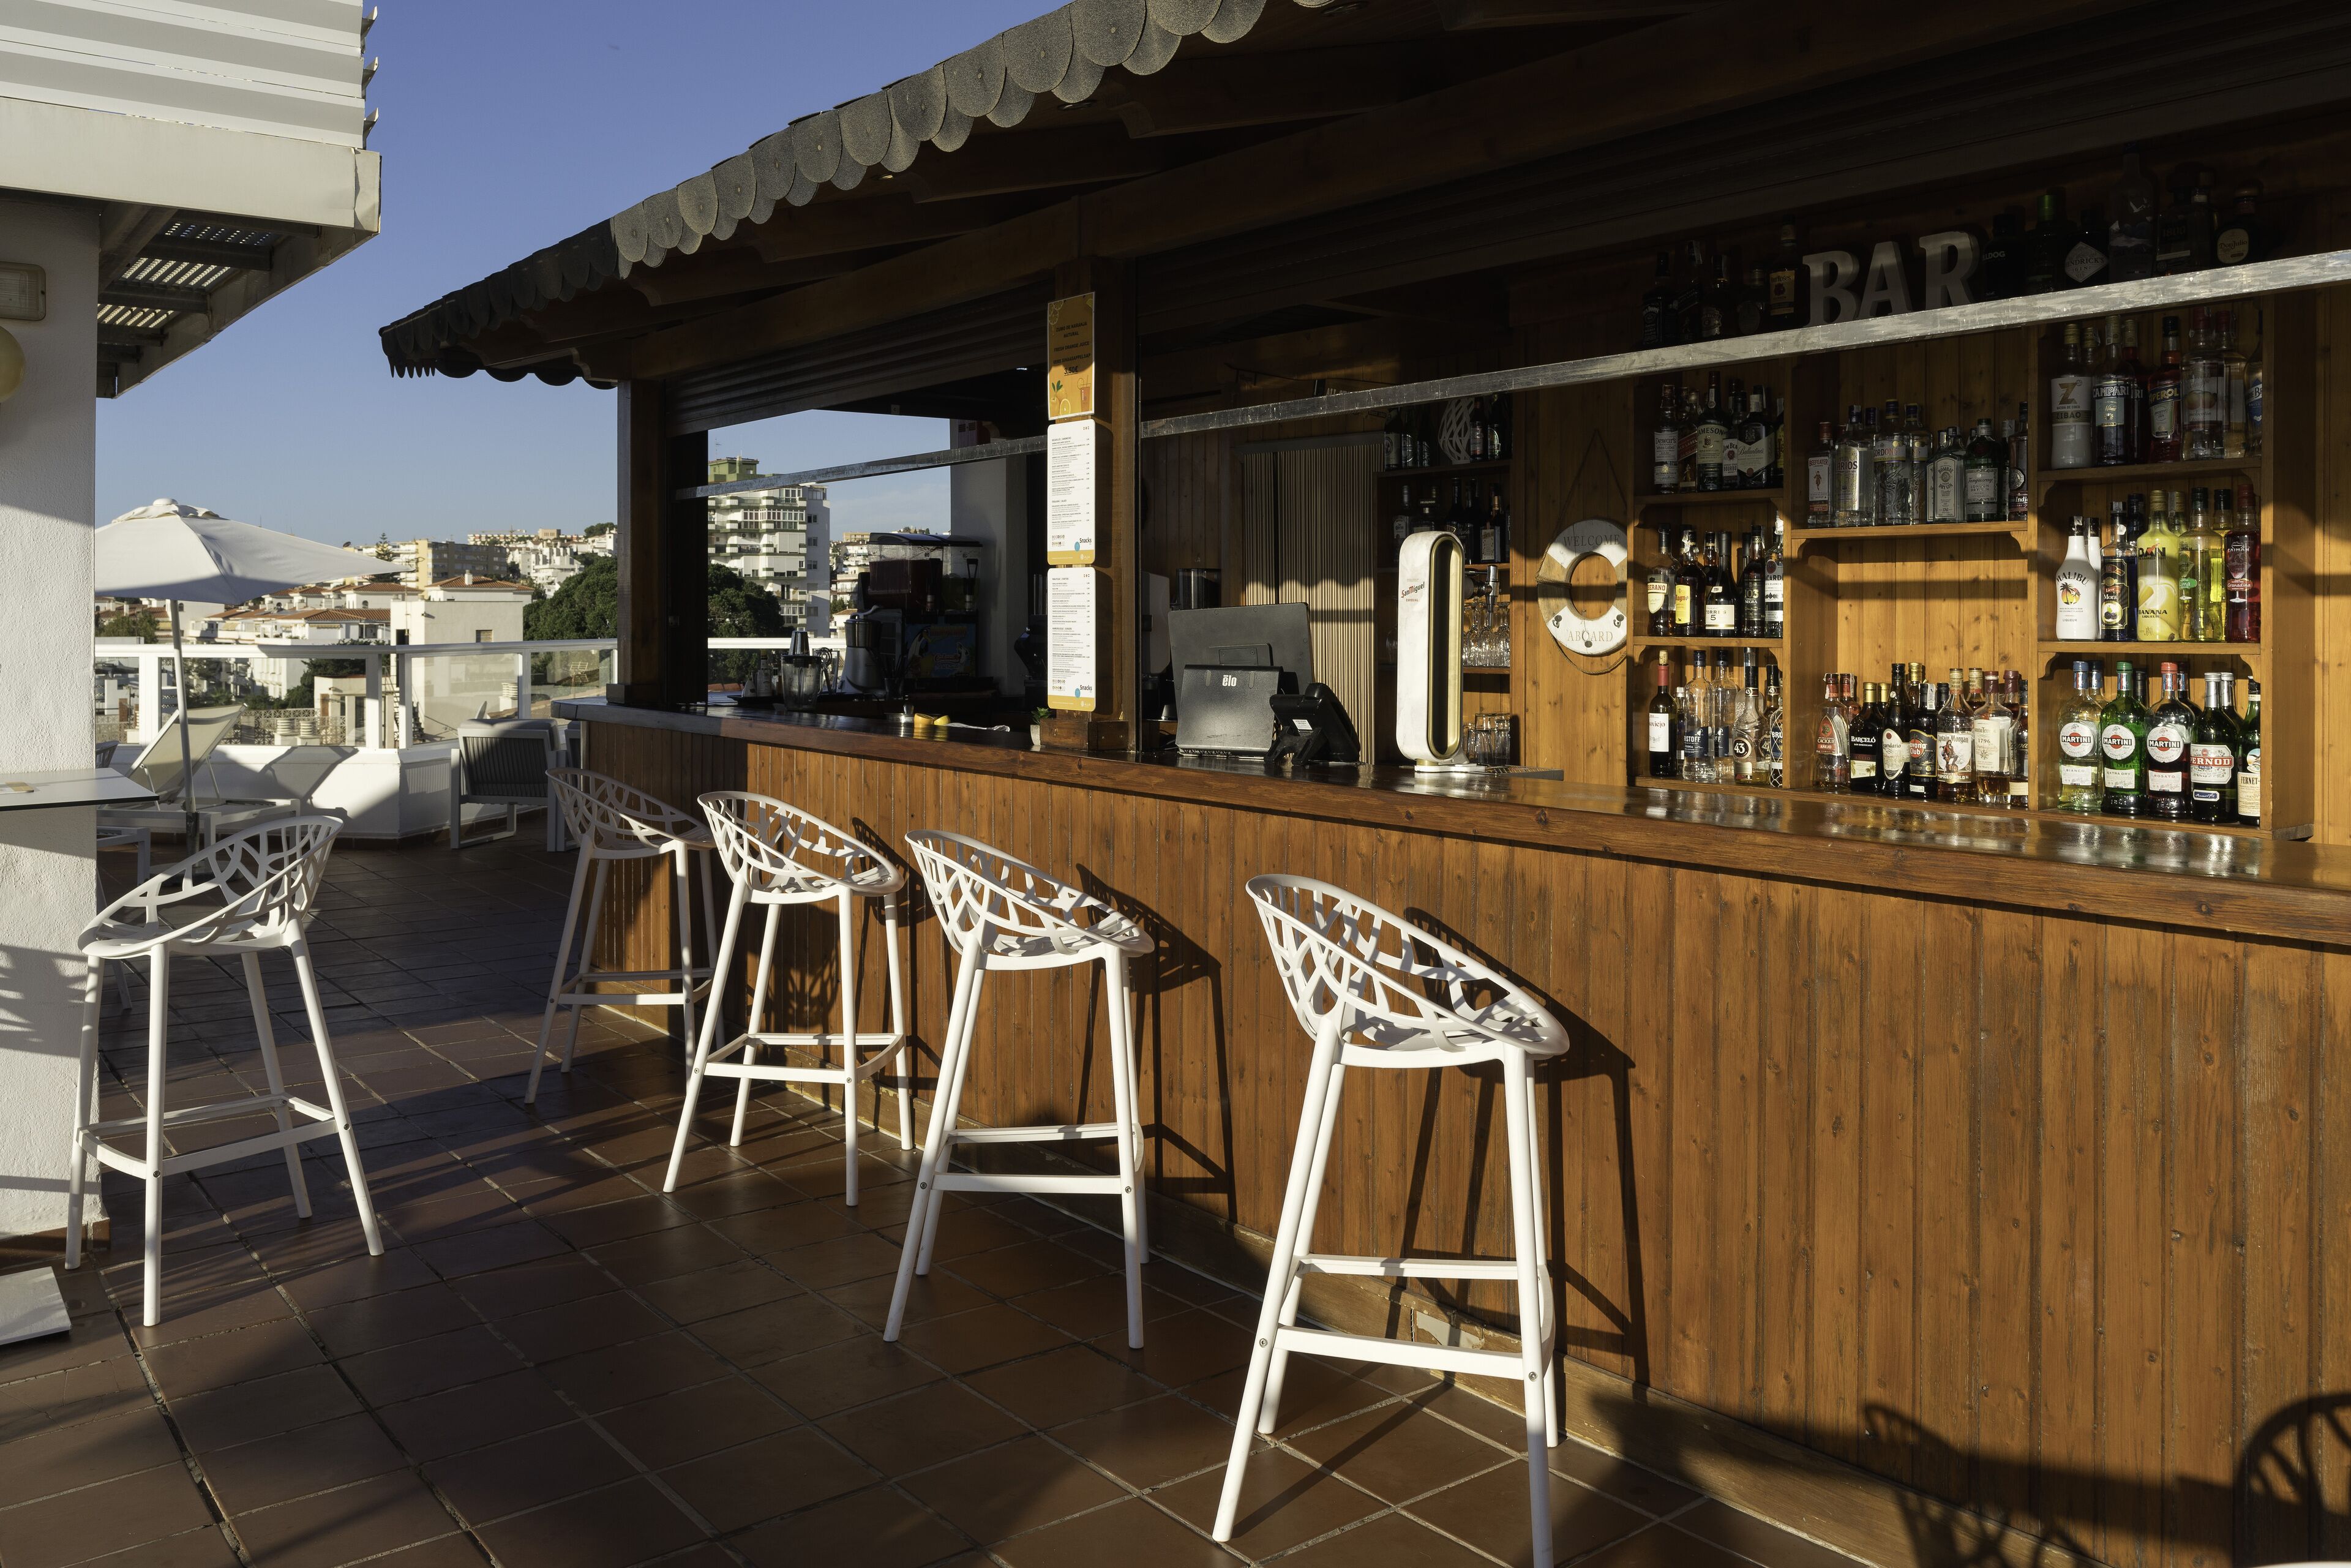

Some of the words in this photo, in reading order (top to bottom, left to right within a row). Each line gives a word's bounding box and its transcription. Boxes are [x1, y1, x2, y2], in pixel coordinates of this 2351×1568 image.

[1802, 231, 1975, 328] BAR
[1064, 366, 1078, 375] 3,50€
[2093, 385, 2129, 398] CAMPARI
[1739, 445, 1764, 456] Ballantine's
[1938, 466, 1954, 475] BOMBAY
[1564, 534, 1620, 547] WELCOME
[2057, 571, 2089, 585] MALIBU
[1567, 631, 1613, 642] ABOARD
[1734, 742, 1745, 754] 43
